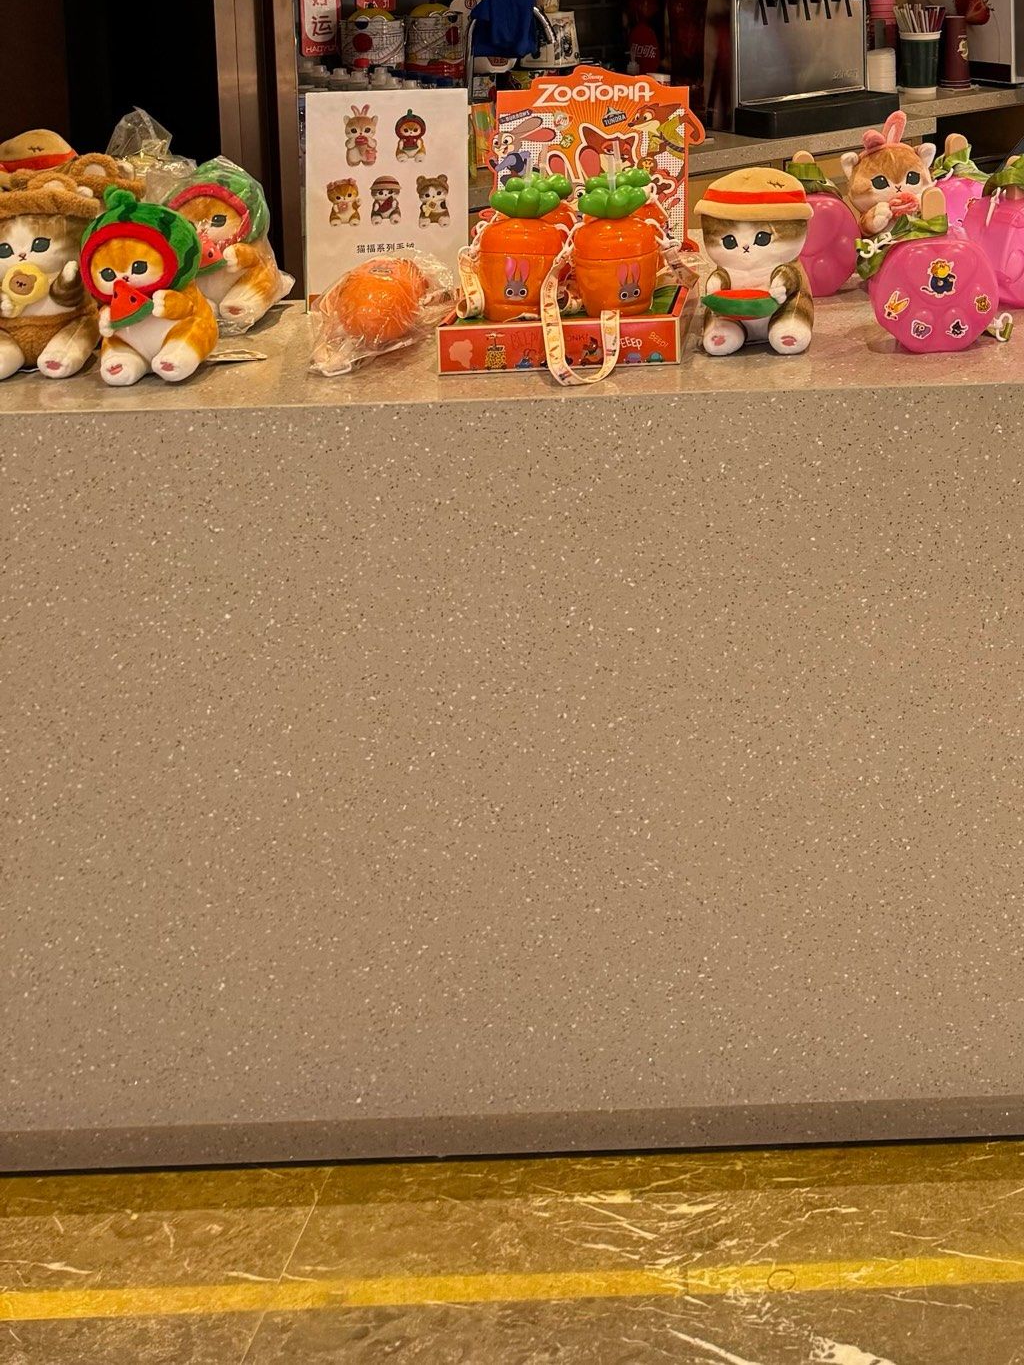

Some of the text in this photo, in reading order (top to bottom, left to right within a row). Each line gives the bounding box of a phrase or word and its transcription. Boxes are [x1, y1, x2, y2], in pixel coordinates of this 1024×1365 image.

[580, 72, 603, 81] Disney
[532, 82, 655, 107] ZOOTOPIA
[604, 115, 627, 126] TUNDRA
